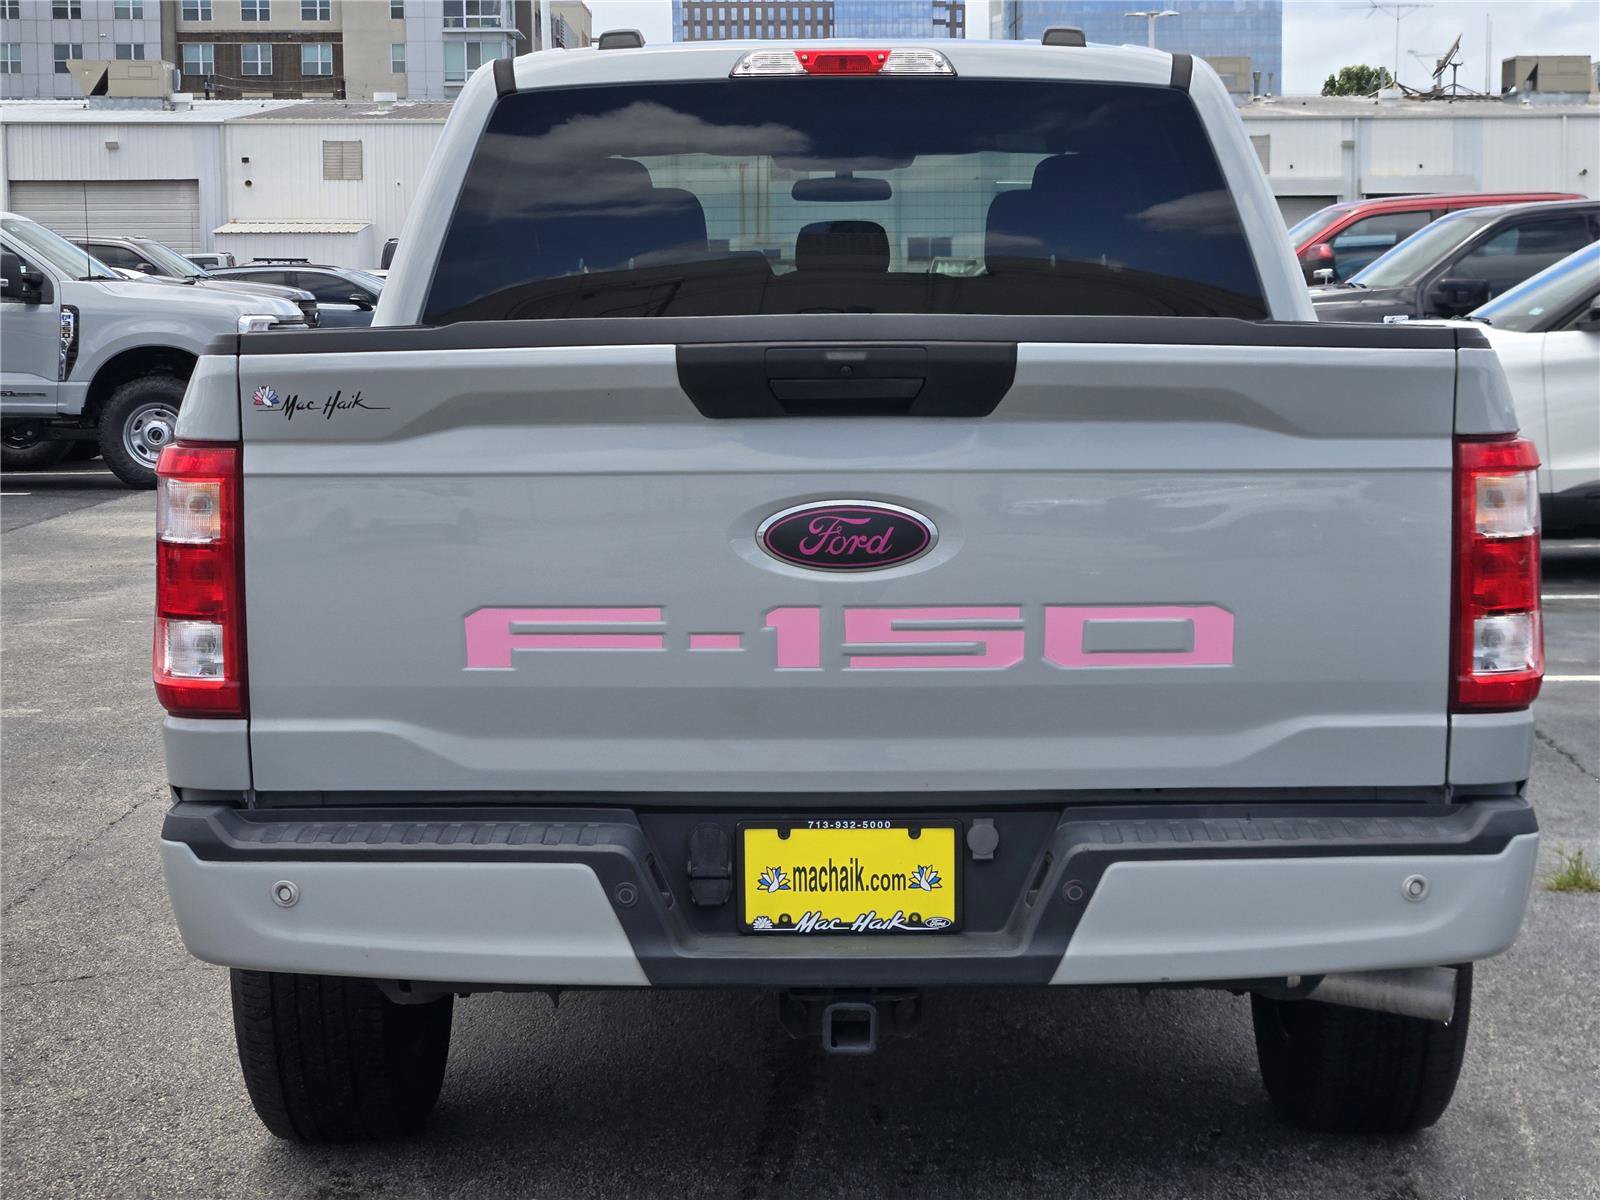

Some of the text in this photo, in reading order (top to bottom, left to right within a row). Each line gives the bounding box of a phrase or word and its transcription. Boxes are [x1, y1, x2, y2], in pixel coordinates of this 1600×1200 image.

[281, 390, 370, 421] Mac Haik
[799, 515, 896, 556] Ford
[463, 604, 1235, 671] F-150
[808, 821, 891, 829] 713-932-5000
[792, 858, 907, 892] machaik.com
[795, 911, 911, 932] Mac Haik
